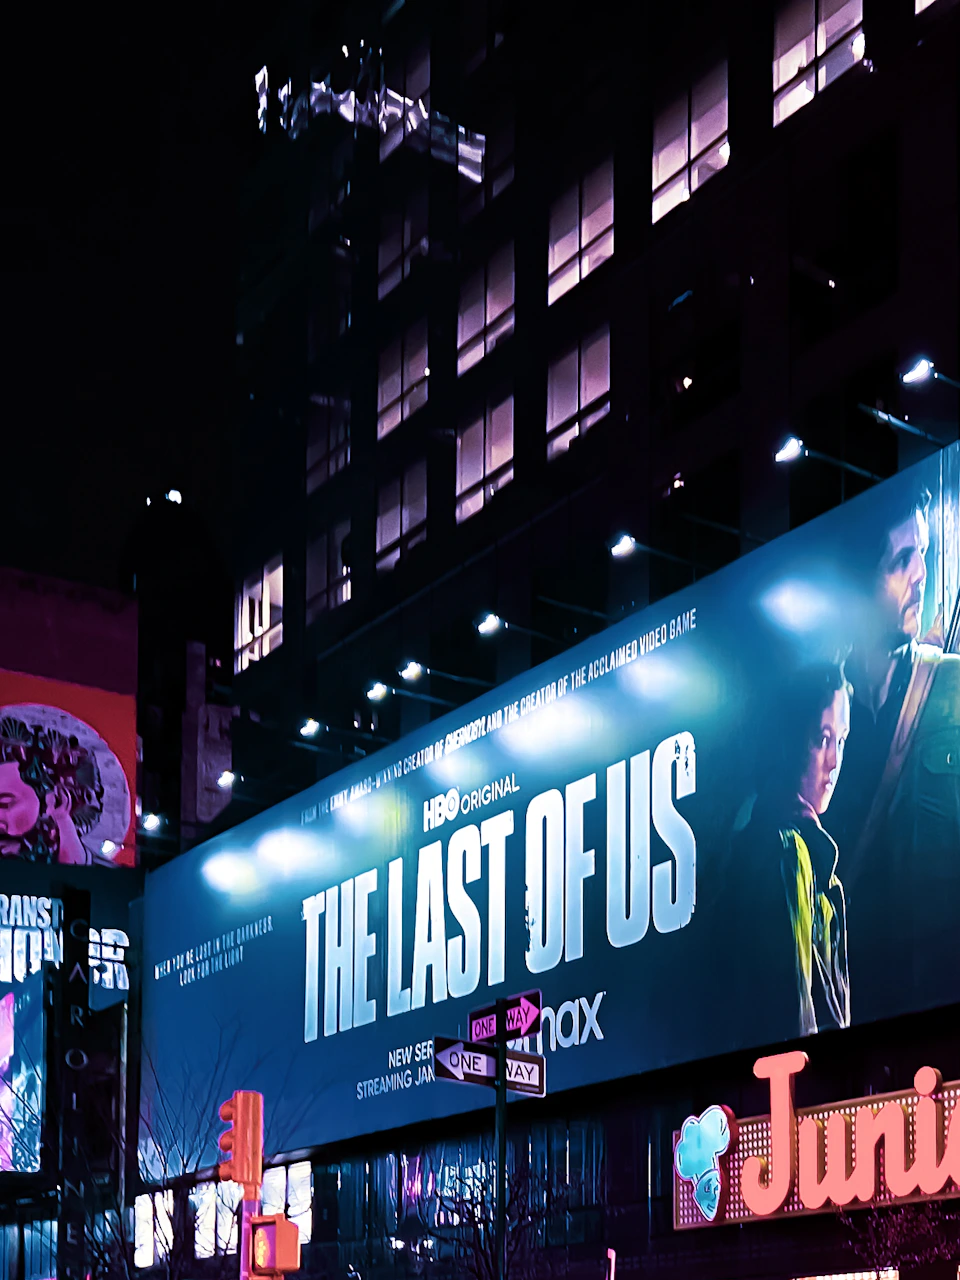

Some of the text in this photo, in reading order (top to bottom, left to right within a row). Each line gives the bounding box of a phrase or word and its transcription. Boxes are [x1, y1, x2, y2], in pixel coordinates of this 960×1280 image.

[403, 745, 433, 775] CREATOR
[434, 739, 444, 760] OF
[487, 708, 502, 734] AND
[503, 701, 519, 725] THE
[520, 682, 556, 716] CREATOR
[557, 675, 569, 698] OF
[570, 665, 586, 691] THE
[587, 639, 638, 683] ACCLAIMED
[639, 623, 667, 656] VIDEO
[669, 607, 697, 640] GAME
[423, 772, 521, 833] HBO ORIGINAL
[302, 731, 697, 1043] THE LAST OF US
[474, 1004, 531, 1039] ONE WAY
[507, 990, 606, 1056] max
[388, 1040, 434, 1069] NEW SER
[449, 1051, 483, 1073] ONE
[356, 1065, 436, 1100] STREAMING JAN
